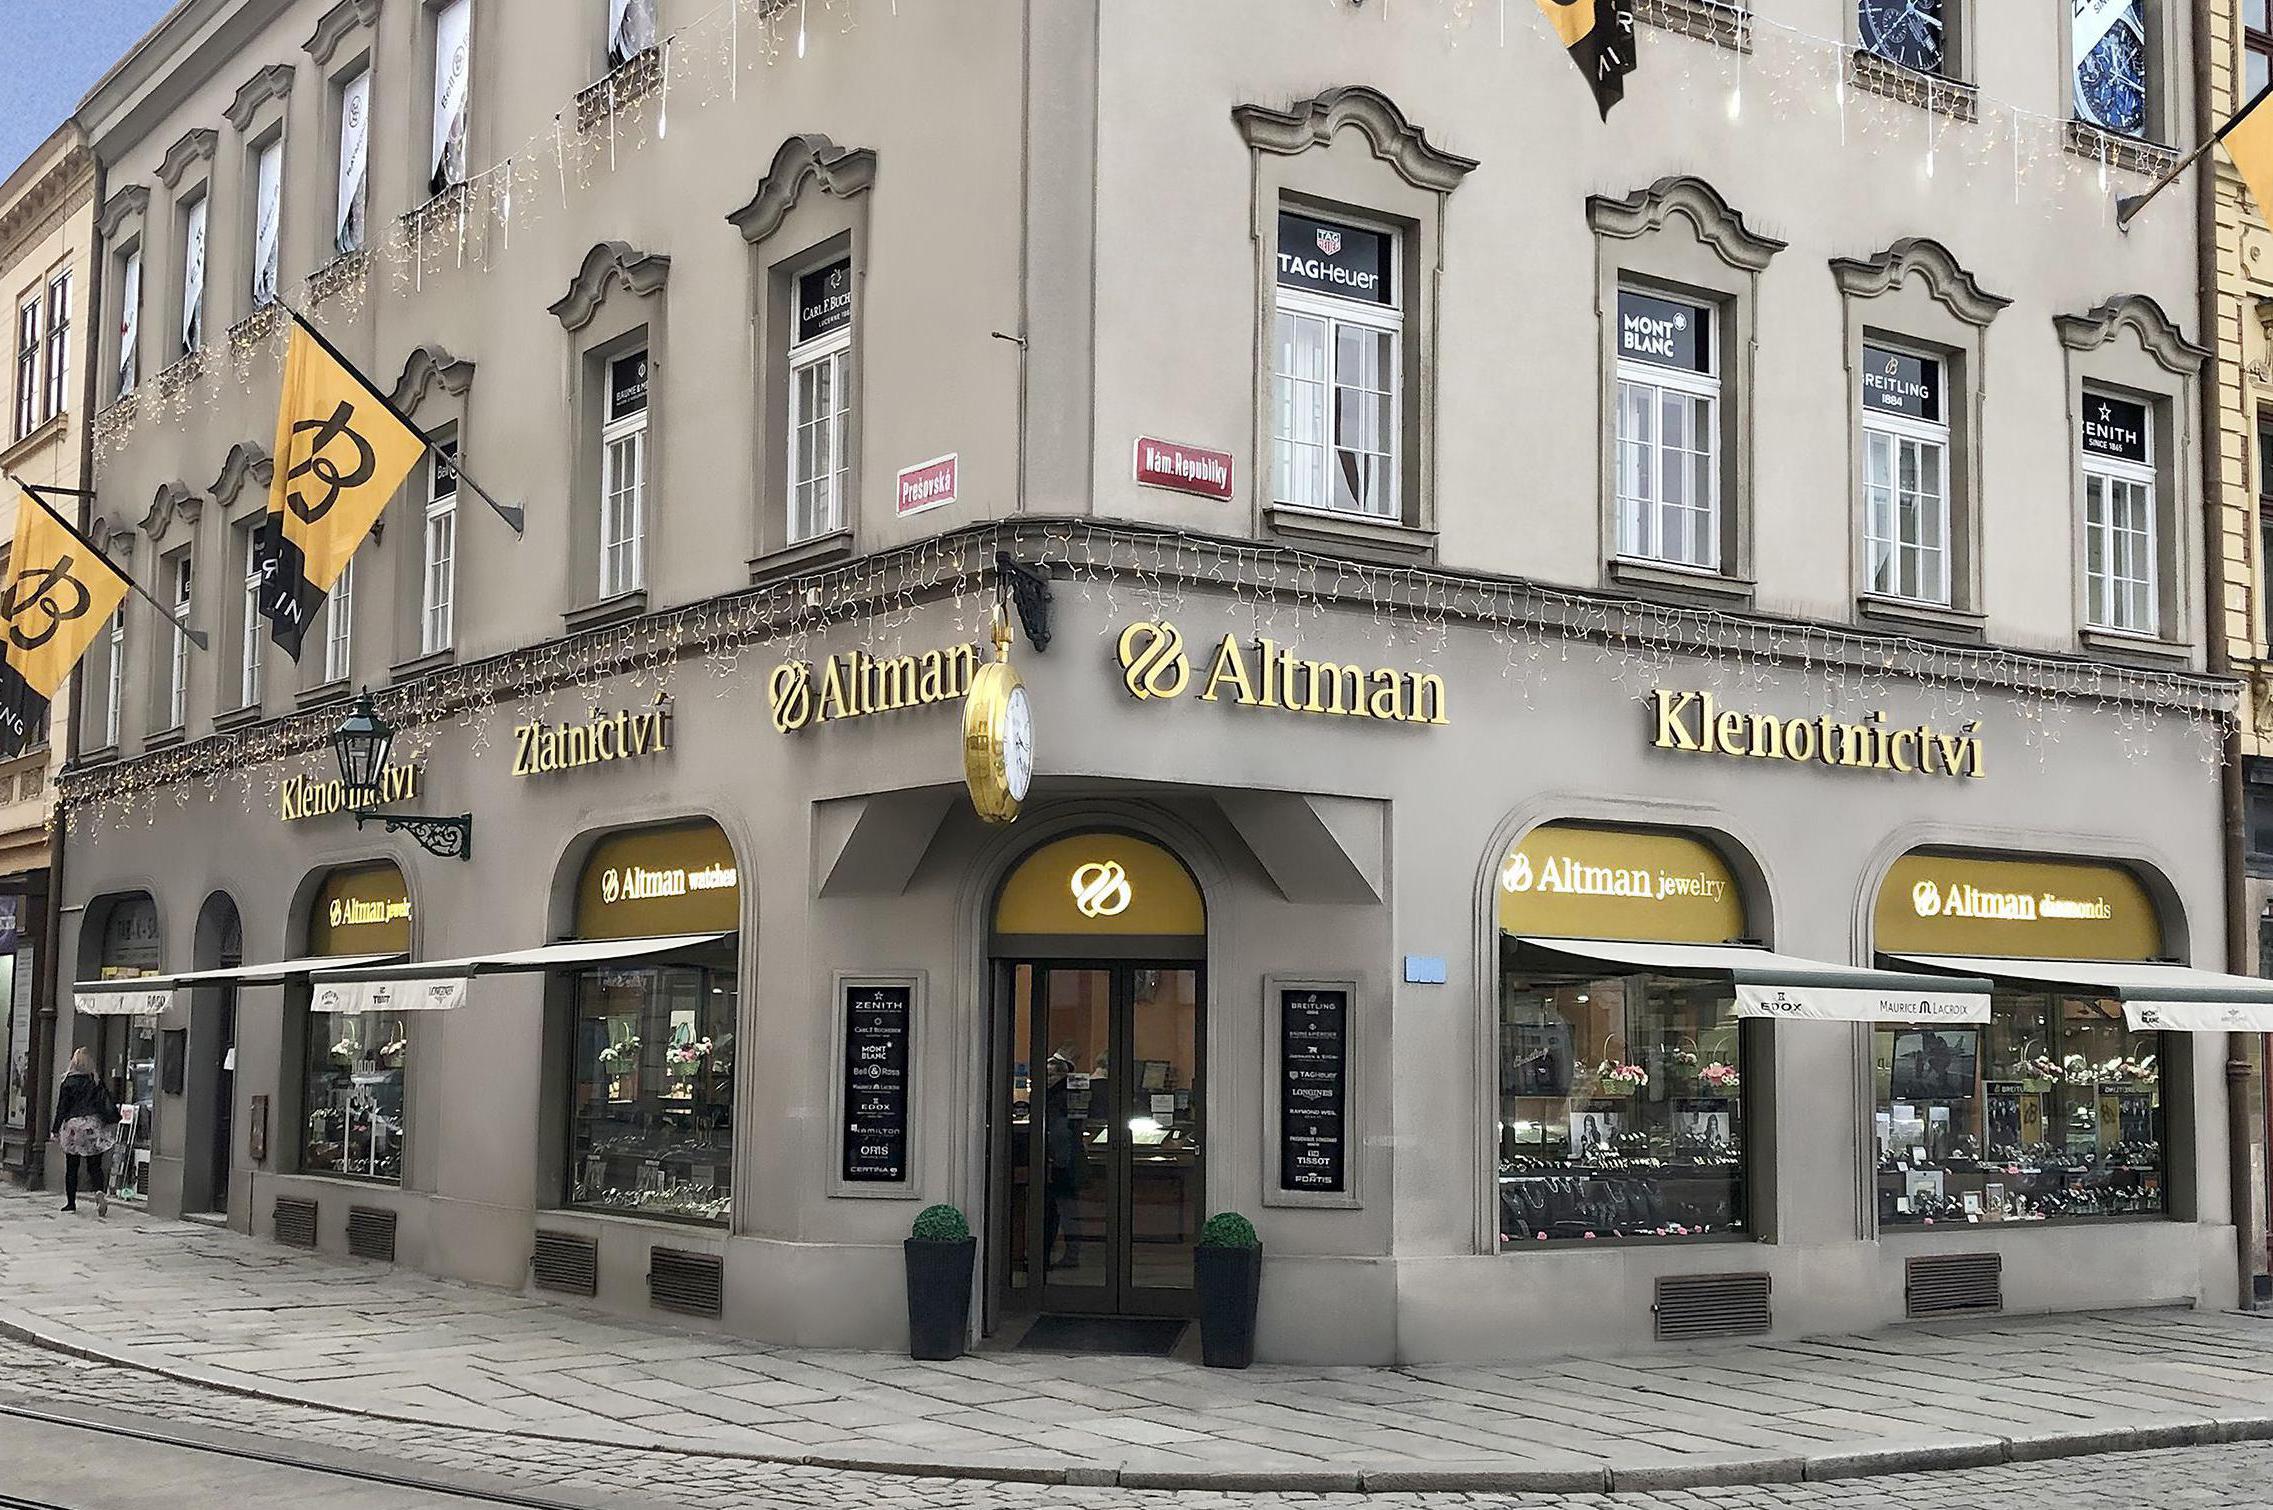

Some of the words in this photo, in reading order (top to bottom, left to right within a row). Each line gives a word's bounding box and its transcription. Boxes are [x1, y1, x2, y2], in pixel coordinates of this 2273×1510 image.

[803, 304, 824, 322] CARL
[1623, 313, 1674, 340] MONT
[1623, 330, 1675, 358] BLANC
[1881, 393, 1903, 407] 1884
[902, 468, 951, 504] Prešovská
[815, 642, 976, 723] Altman
[1201, 632, 1451, 726] Altman
[511, 692, 668, 776] Zlatnictví
[1652, 688, 1986, 779] Klenotnictví
[620, 866, 687, 900] Altman
[1536, 855, 1653, 898] Altman
[1655, 868, 1726, 903] jewelry
[341, 897, 386, 925] Altman
[1942, 883, 2038, 920] Altman
[855, 1001, 903, 1009] ZENITH
[1760, 1002, 1802, 1012] EDOX
[1879, 1000, 1917, 1015] MAURICE
[1932, 1001, 1968, 1016] LACROIX
[861, 1052, 887, 1060] BLANC
[1292, 1088, 1333, 1098] LONGINES
[860, 1145, 889, 1156] ORIS
[1296, 1156, 1331, 1165] TISSOT
